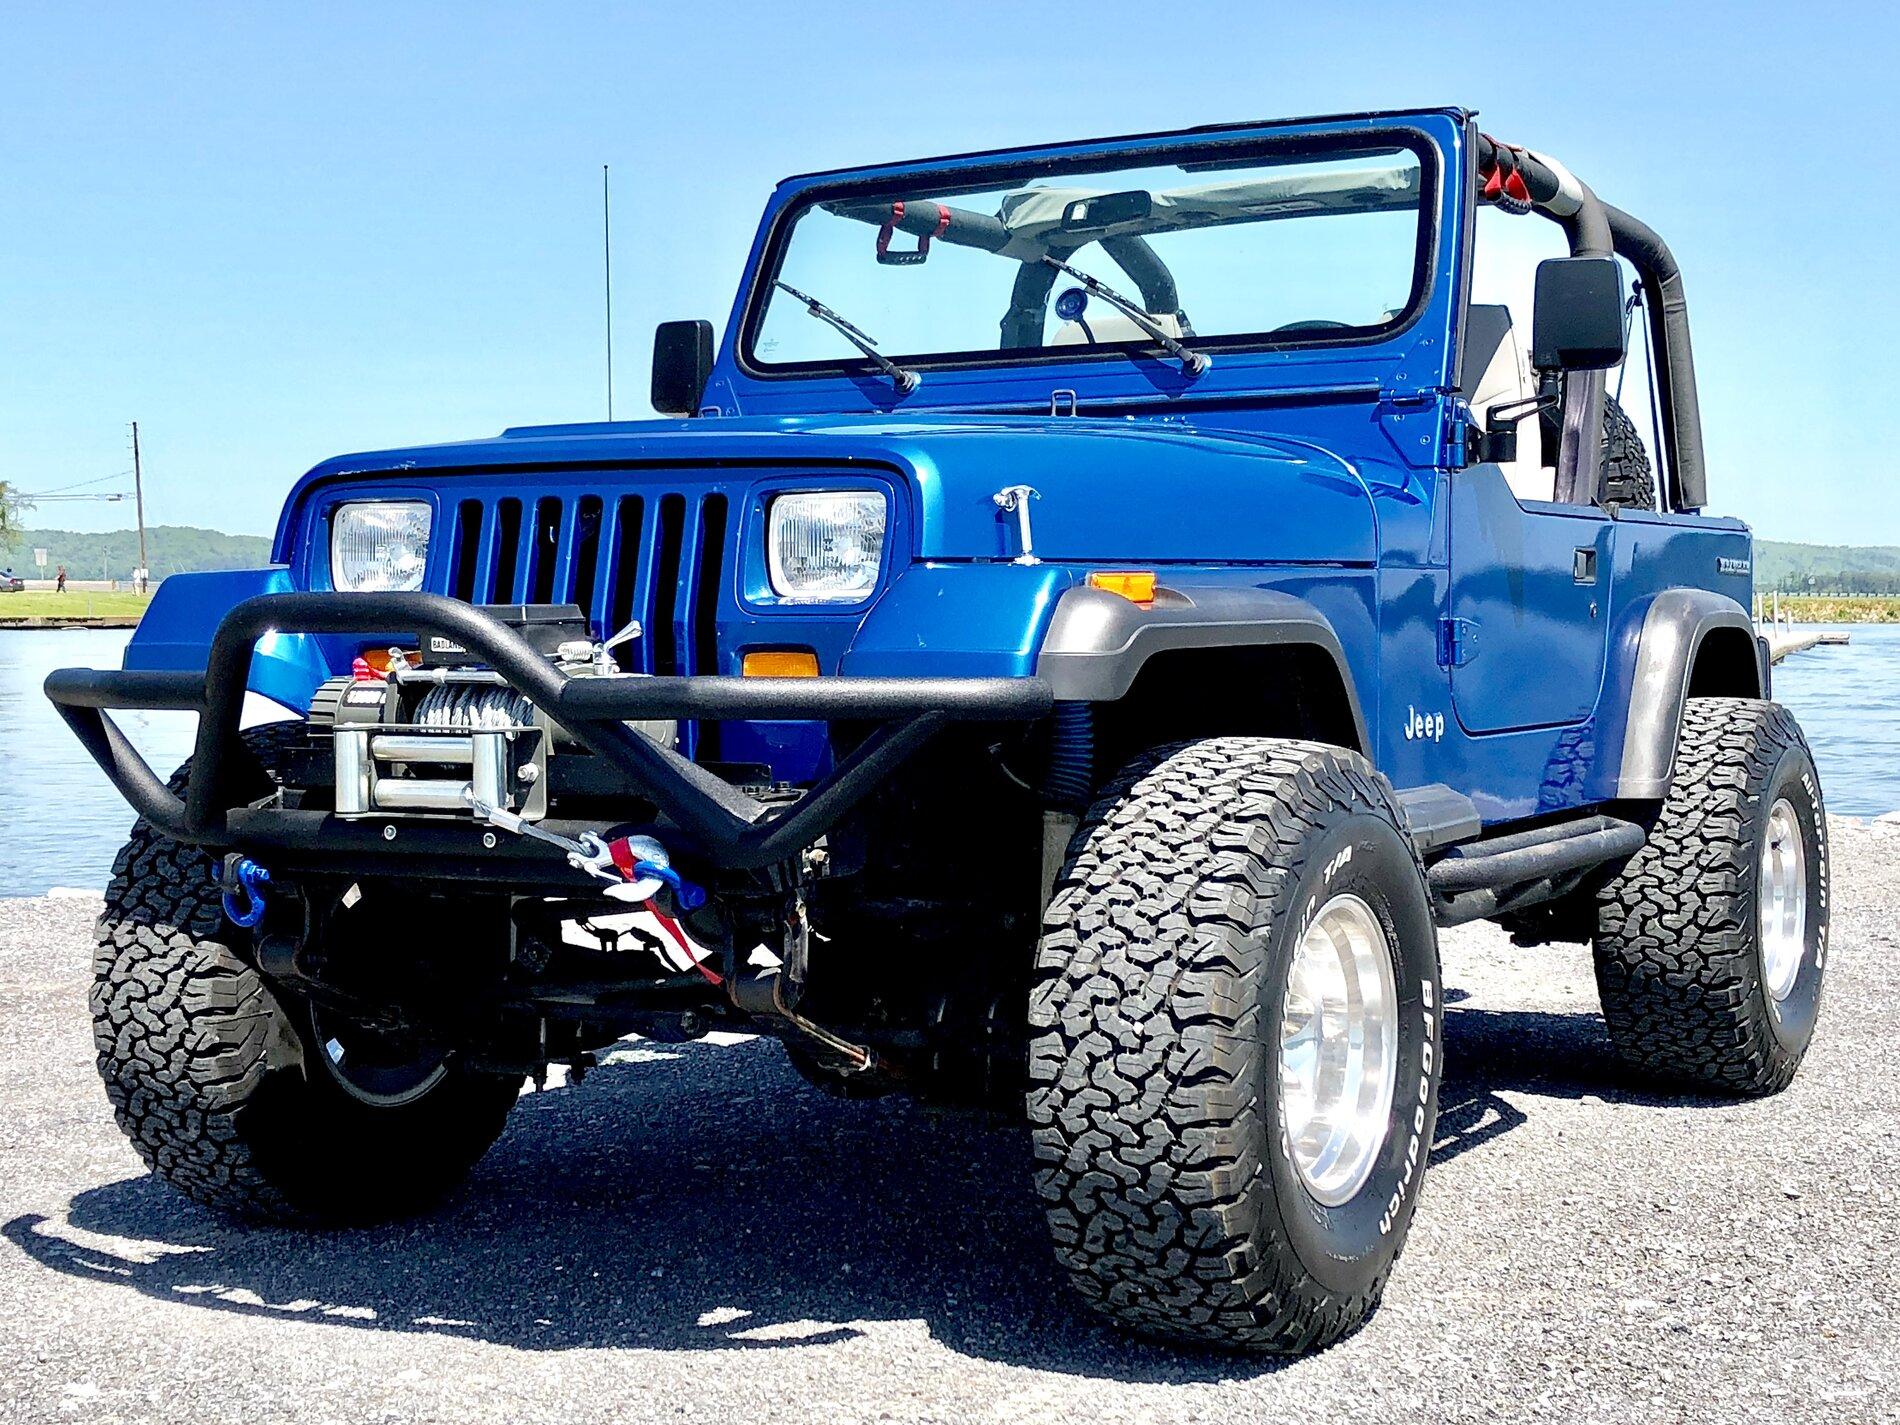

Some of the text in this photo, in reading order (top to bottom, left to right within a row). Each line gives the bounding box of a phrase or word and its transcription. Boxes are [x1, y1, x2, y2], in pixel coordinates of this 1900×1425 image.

[1403, 704, 1444, 743] Jeep
[1323, 845, 1353, 885] T/A
[1379, 979, 1434, 1235] BFGoodrich
